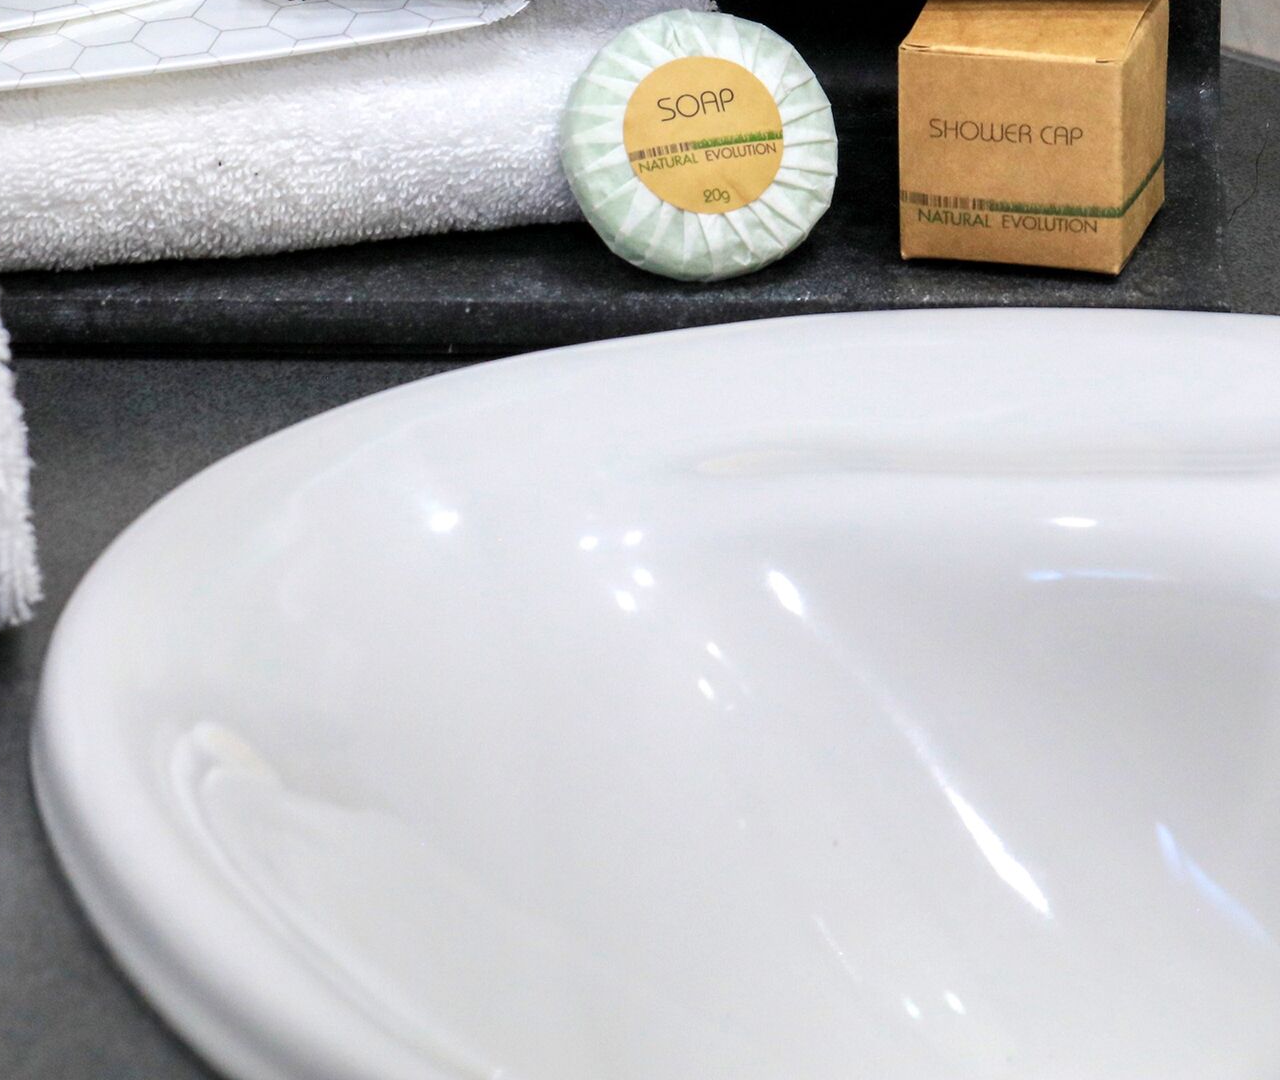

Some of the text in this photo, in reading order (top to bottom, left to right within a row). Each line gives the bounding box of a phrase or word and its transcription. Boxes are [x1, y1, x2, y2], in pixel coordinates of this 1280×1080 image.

[657, 87, 735, 122] SOAP
[929, 117, 1084, 146] SHOWER CAP
[638, 142, 777, 174] NATURAL EVOLUTION
[703, 187, 731, 204] 20g
[917, 208, 1098, 234] NATURAL EVOLUTION
